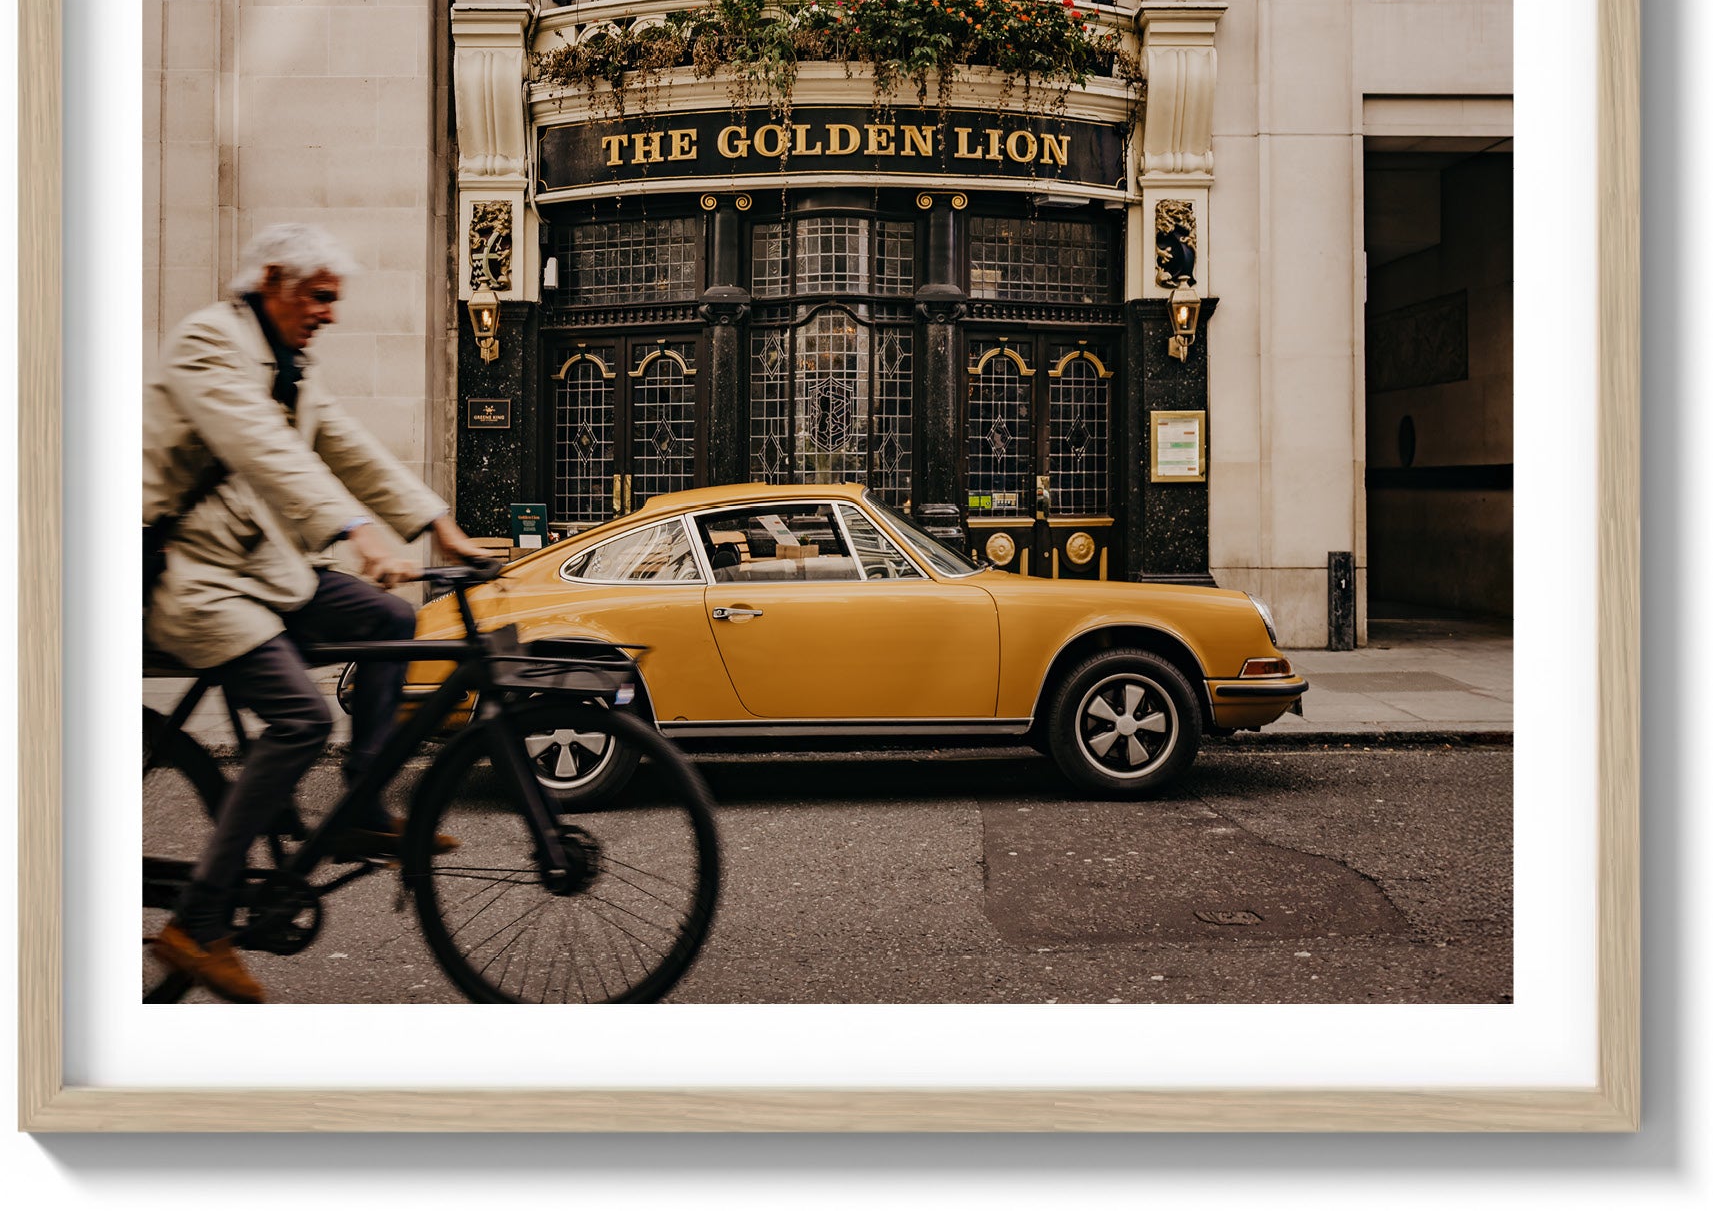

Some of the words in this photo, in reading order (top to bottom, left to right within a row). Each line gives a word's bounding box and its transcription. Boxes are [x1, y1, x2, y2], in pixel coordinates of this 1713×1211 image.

[601, 128, 698, 166] THE
[716, 123, 937, 159] GOLDEN
[954, 127, 1071, 166] LION
[1340, 578, 1346, 589] 1
